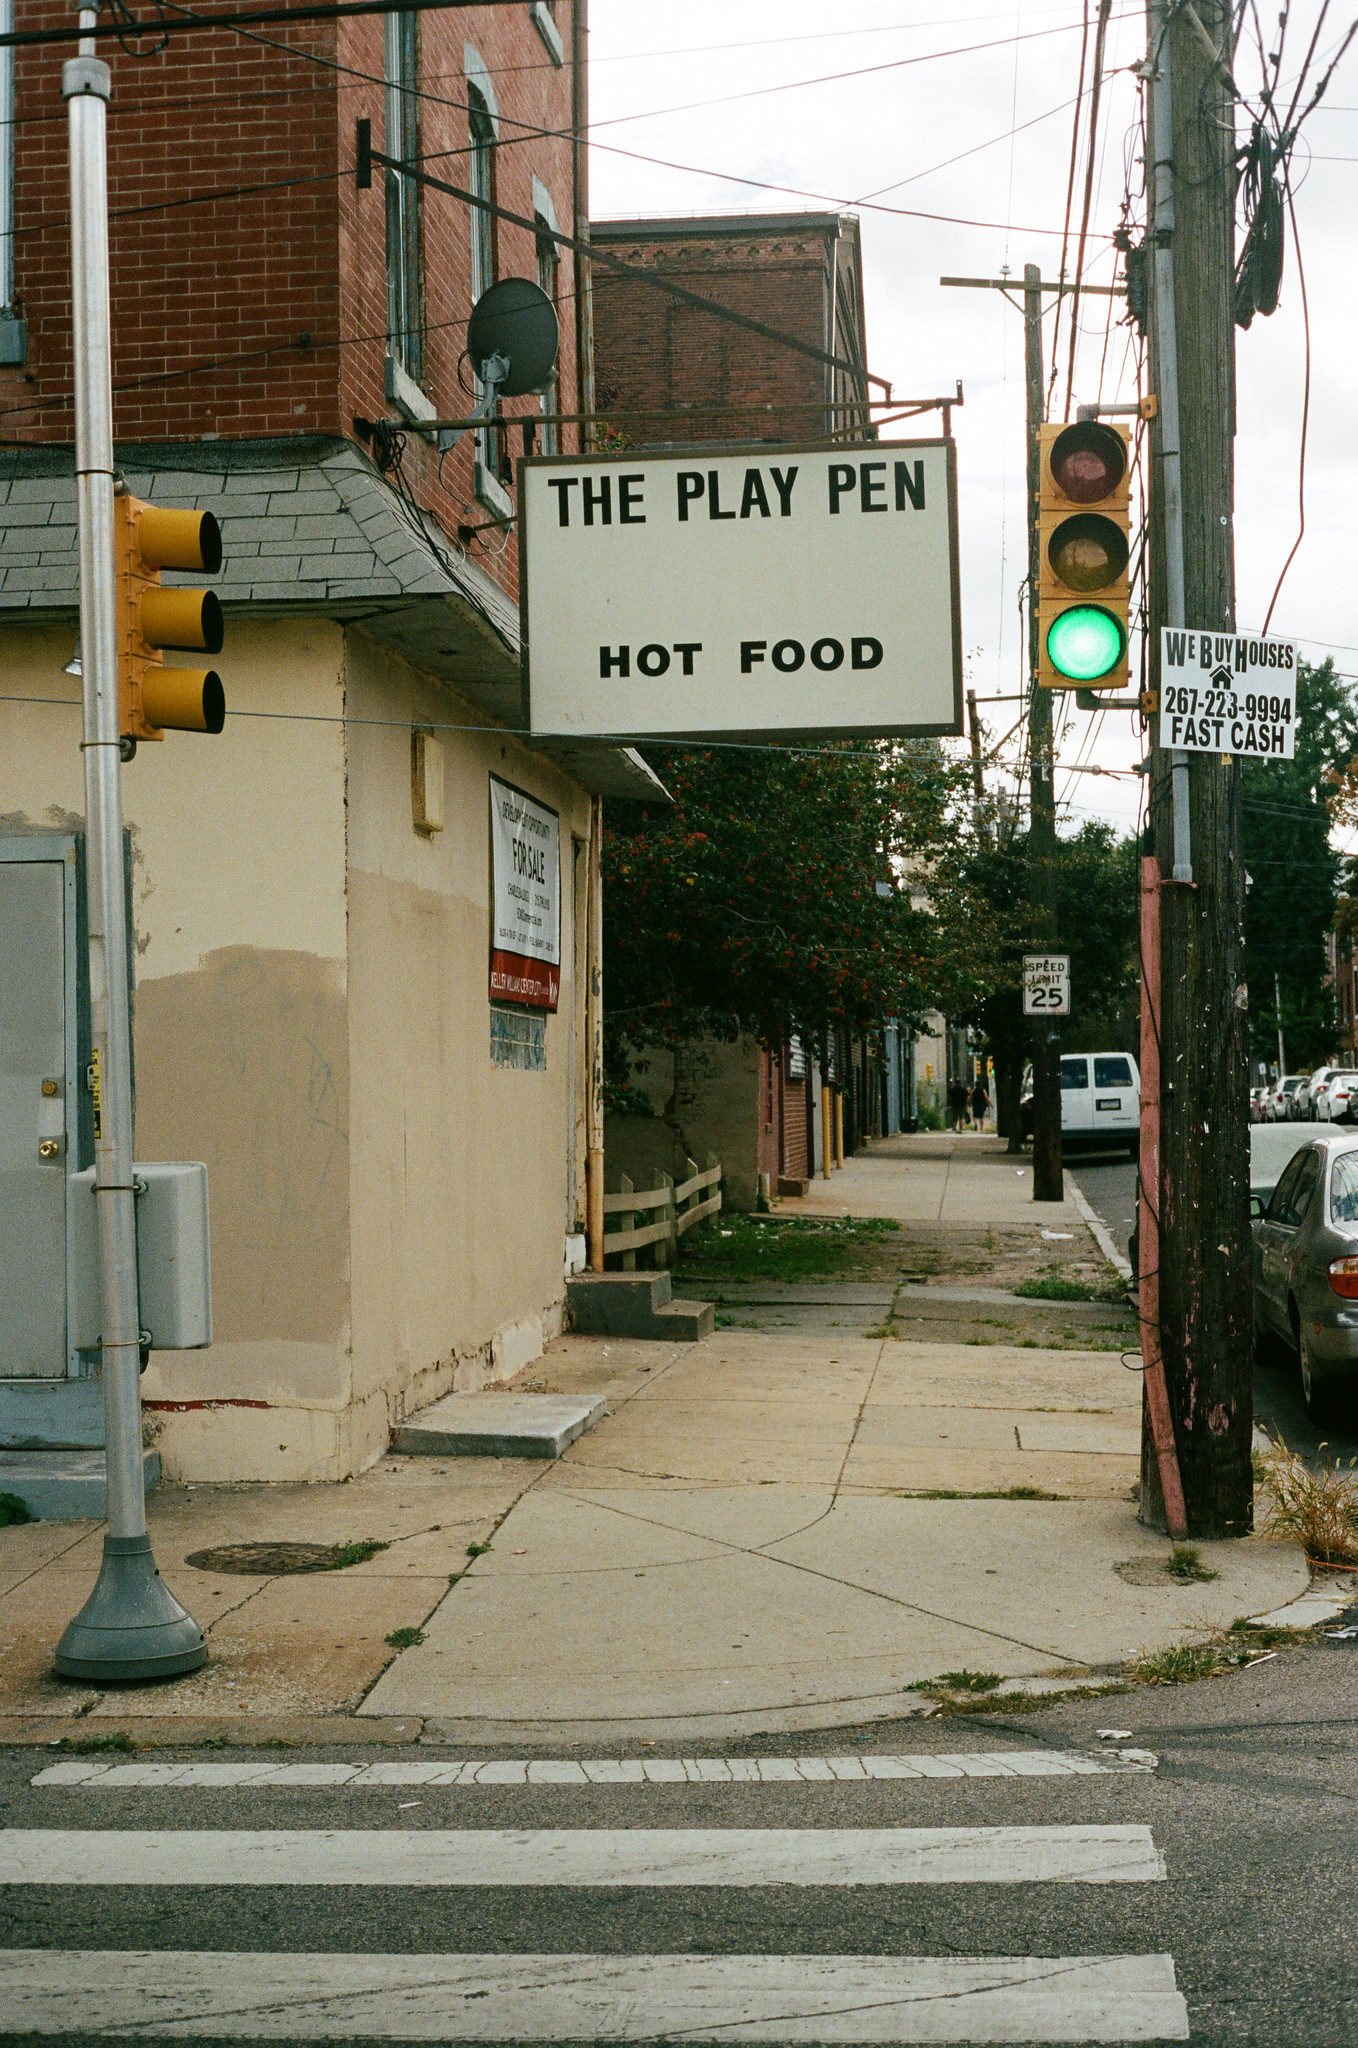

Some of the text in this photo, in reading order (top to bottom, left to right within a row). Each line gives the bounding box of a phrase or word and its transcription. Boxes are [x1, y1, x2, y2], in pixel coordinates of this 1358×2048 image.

[547, 459, 926, 528] THE PLAY PEN
[599, 636, 884, 679] HOT FOOD
[1165, 631, 1294, 673] WE BUY HOUSES
[1165, 686, 1292, 724] 267-223-9994
[1171, 716, 1285, 754] FAST CASH
[512, 837, 545, 885] FOR SALE
[1028, 962, 1065, 972] SPEED
[1031, 987, 1063, 1008] 25
